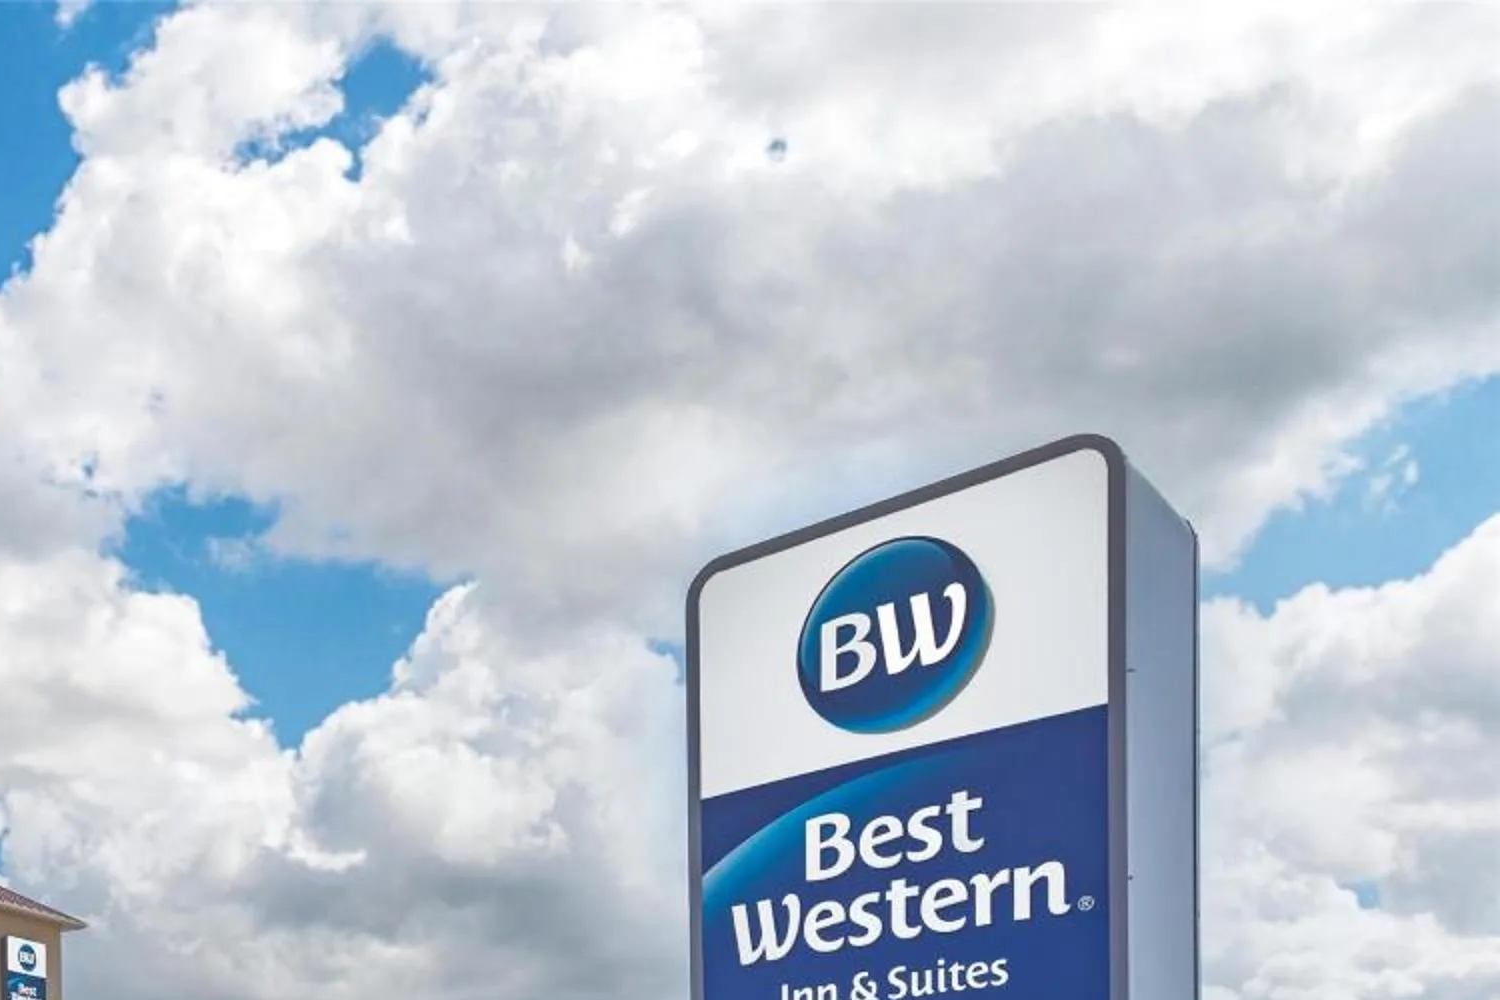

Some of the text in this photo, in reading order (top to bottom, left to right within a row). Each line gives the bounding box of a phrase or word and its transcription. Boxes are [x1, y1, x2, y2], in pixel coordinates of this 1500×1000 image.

[820, 581, 967, 693] BW
[804, 790, 985, 881] Best
[731, 860, 1071, 965] Western
[887, 957, 1010, 1000] Suites
